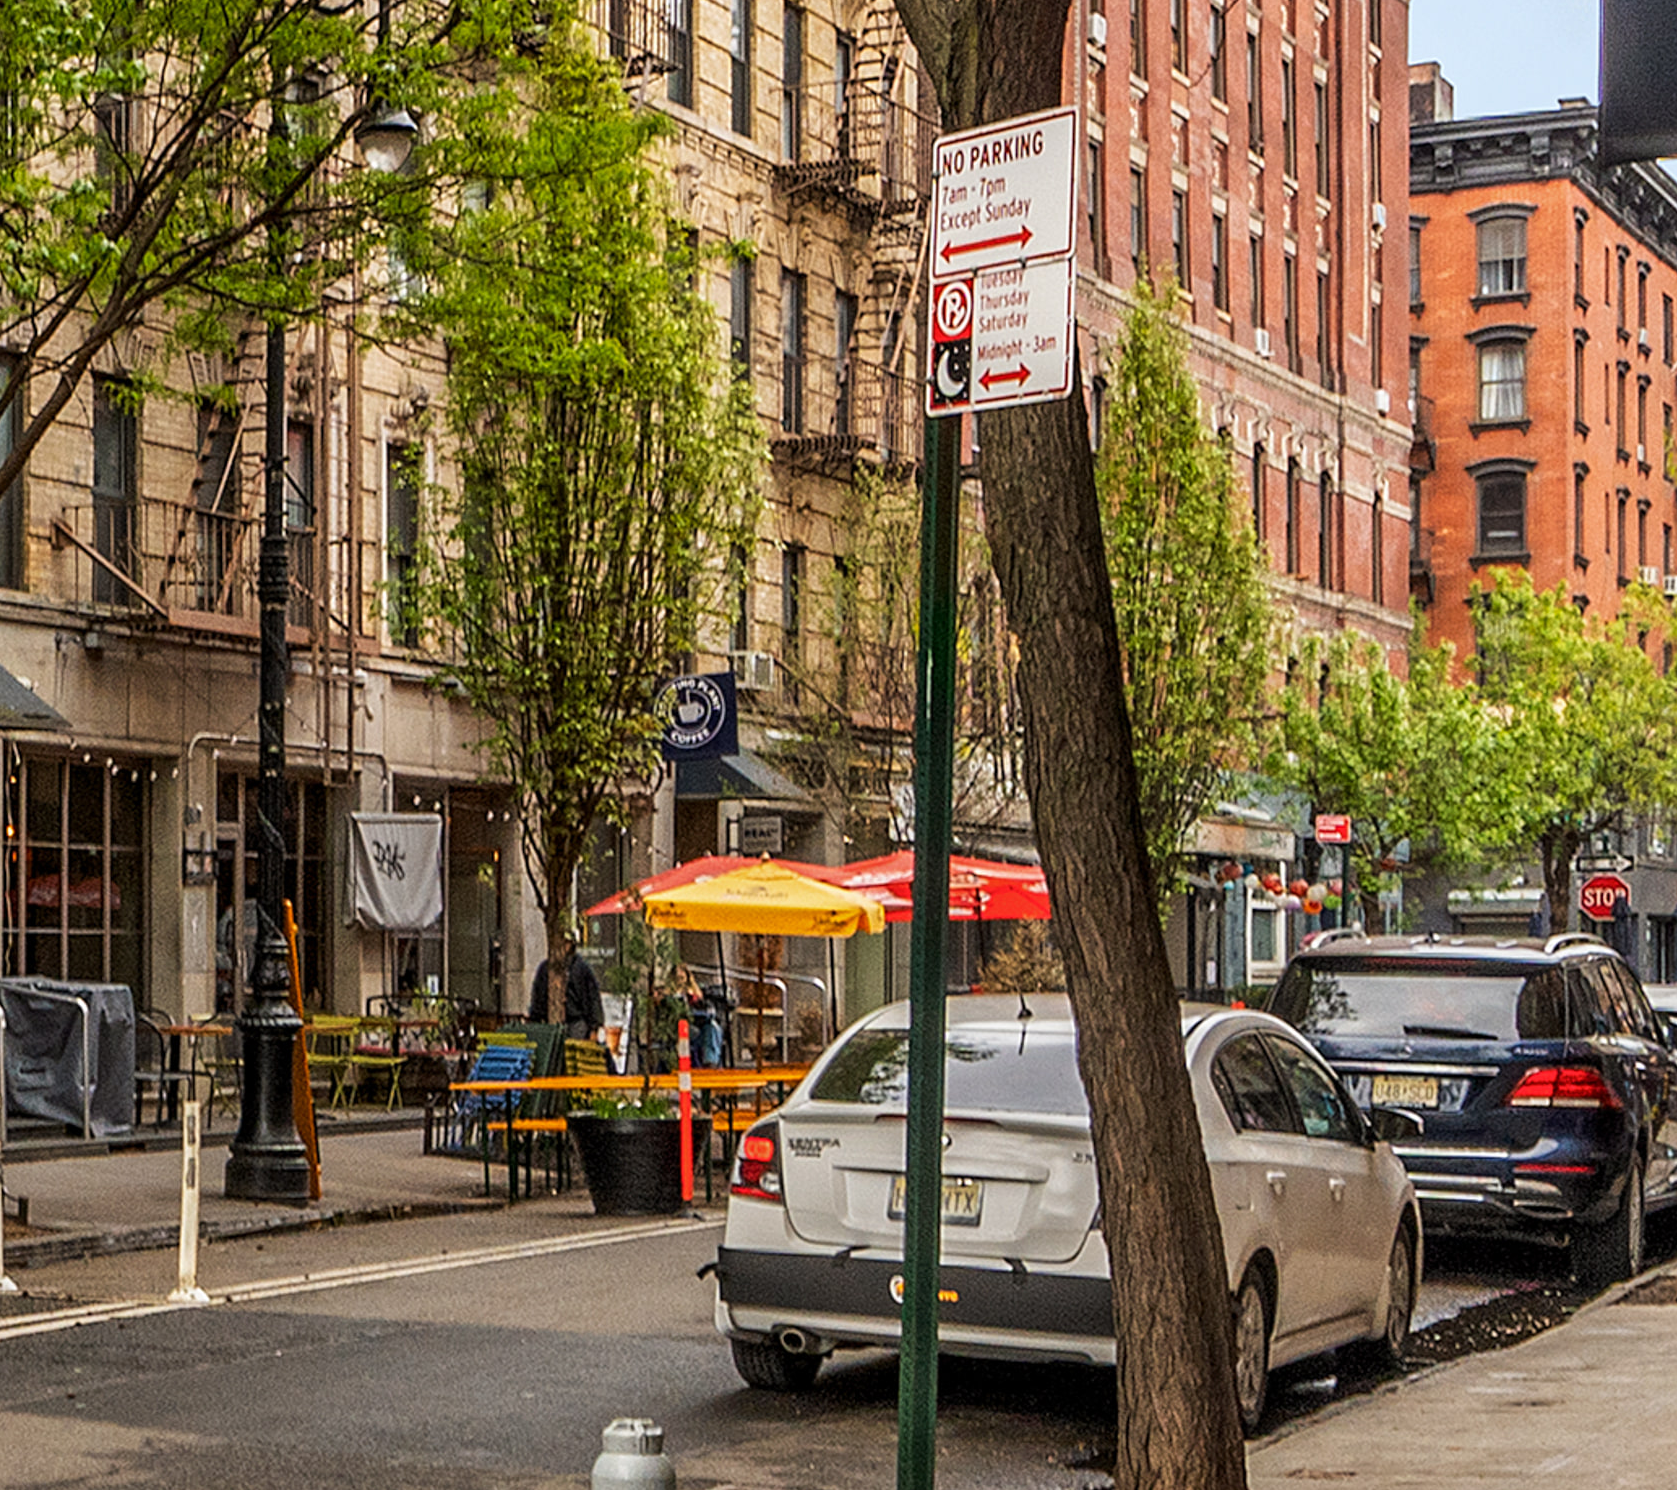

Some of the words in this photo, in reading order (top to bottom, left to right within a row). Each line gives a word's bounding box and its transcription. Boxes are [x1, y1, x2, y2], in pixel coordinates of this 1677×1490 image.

[942, 150, 965, 176] NO
[969, 130, 1044, 171] PARKING
[942, 186, 968, 206] 7am
[980, 177, 1006, 199] 7pm
[940, 205, 981, 232] Except
[986, 197, 1032, 223] Sunday
[980, 269, 1025, 289] Tuesday
[980, 290, 1030, 311] Thursday
[979, 312, 1028, 334] Saturday
[977, 338, 1023, 361] Midnight
[1033, 335, 1057, 353] 3am
[670, 728, 711, 745] COFFEE
